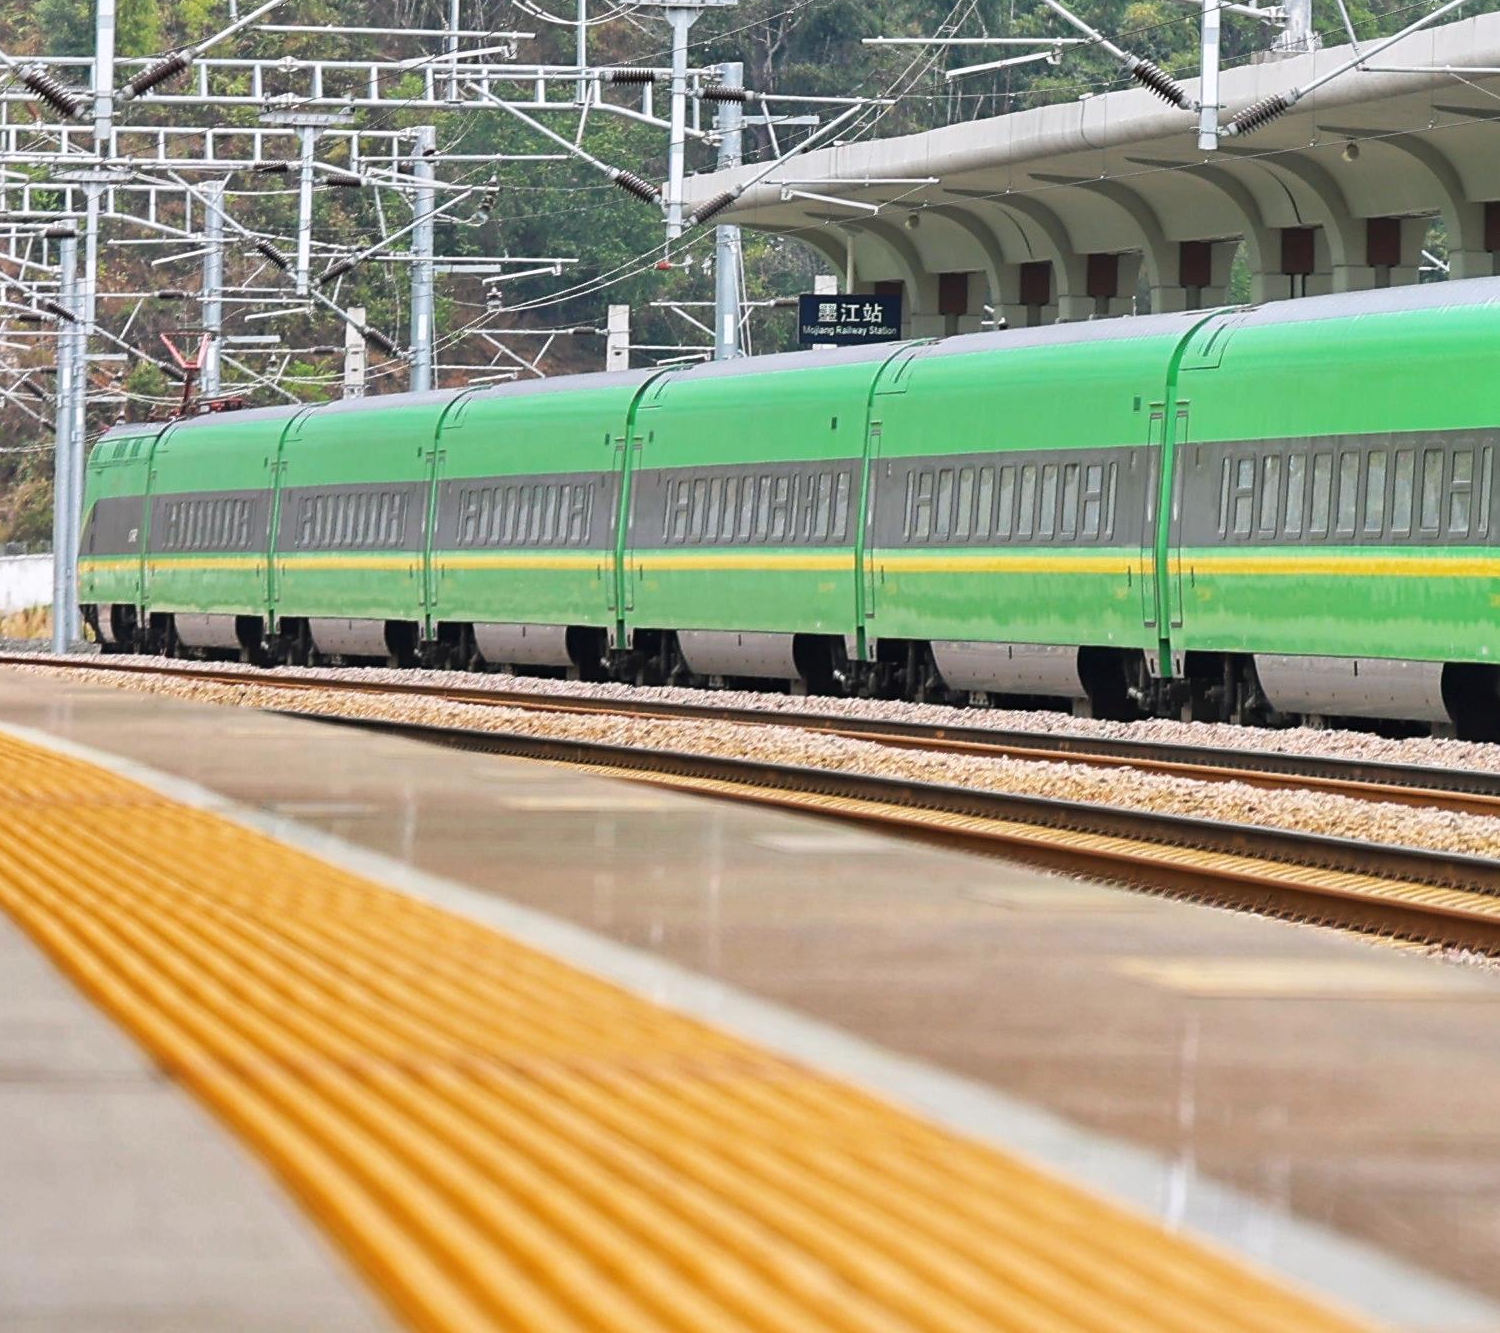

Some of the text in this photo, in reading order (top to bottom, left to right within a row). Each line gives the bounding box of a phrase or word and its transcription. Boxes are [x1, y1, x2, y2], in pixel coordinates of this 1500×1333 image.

[818, 303, 883, 323] 墨江站
[803, 325, 897, 336] Mojiang Railway Station
